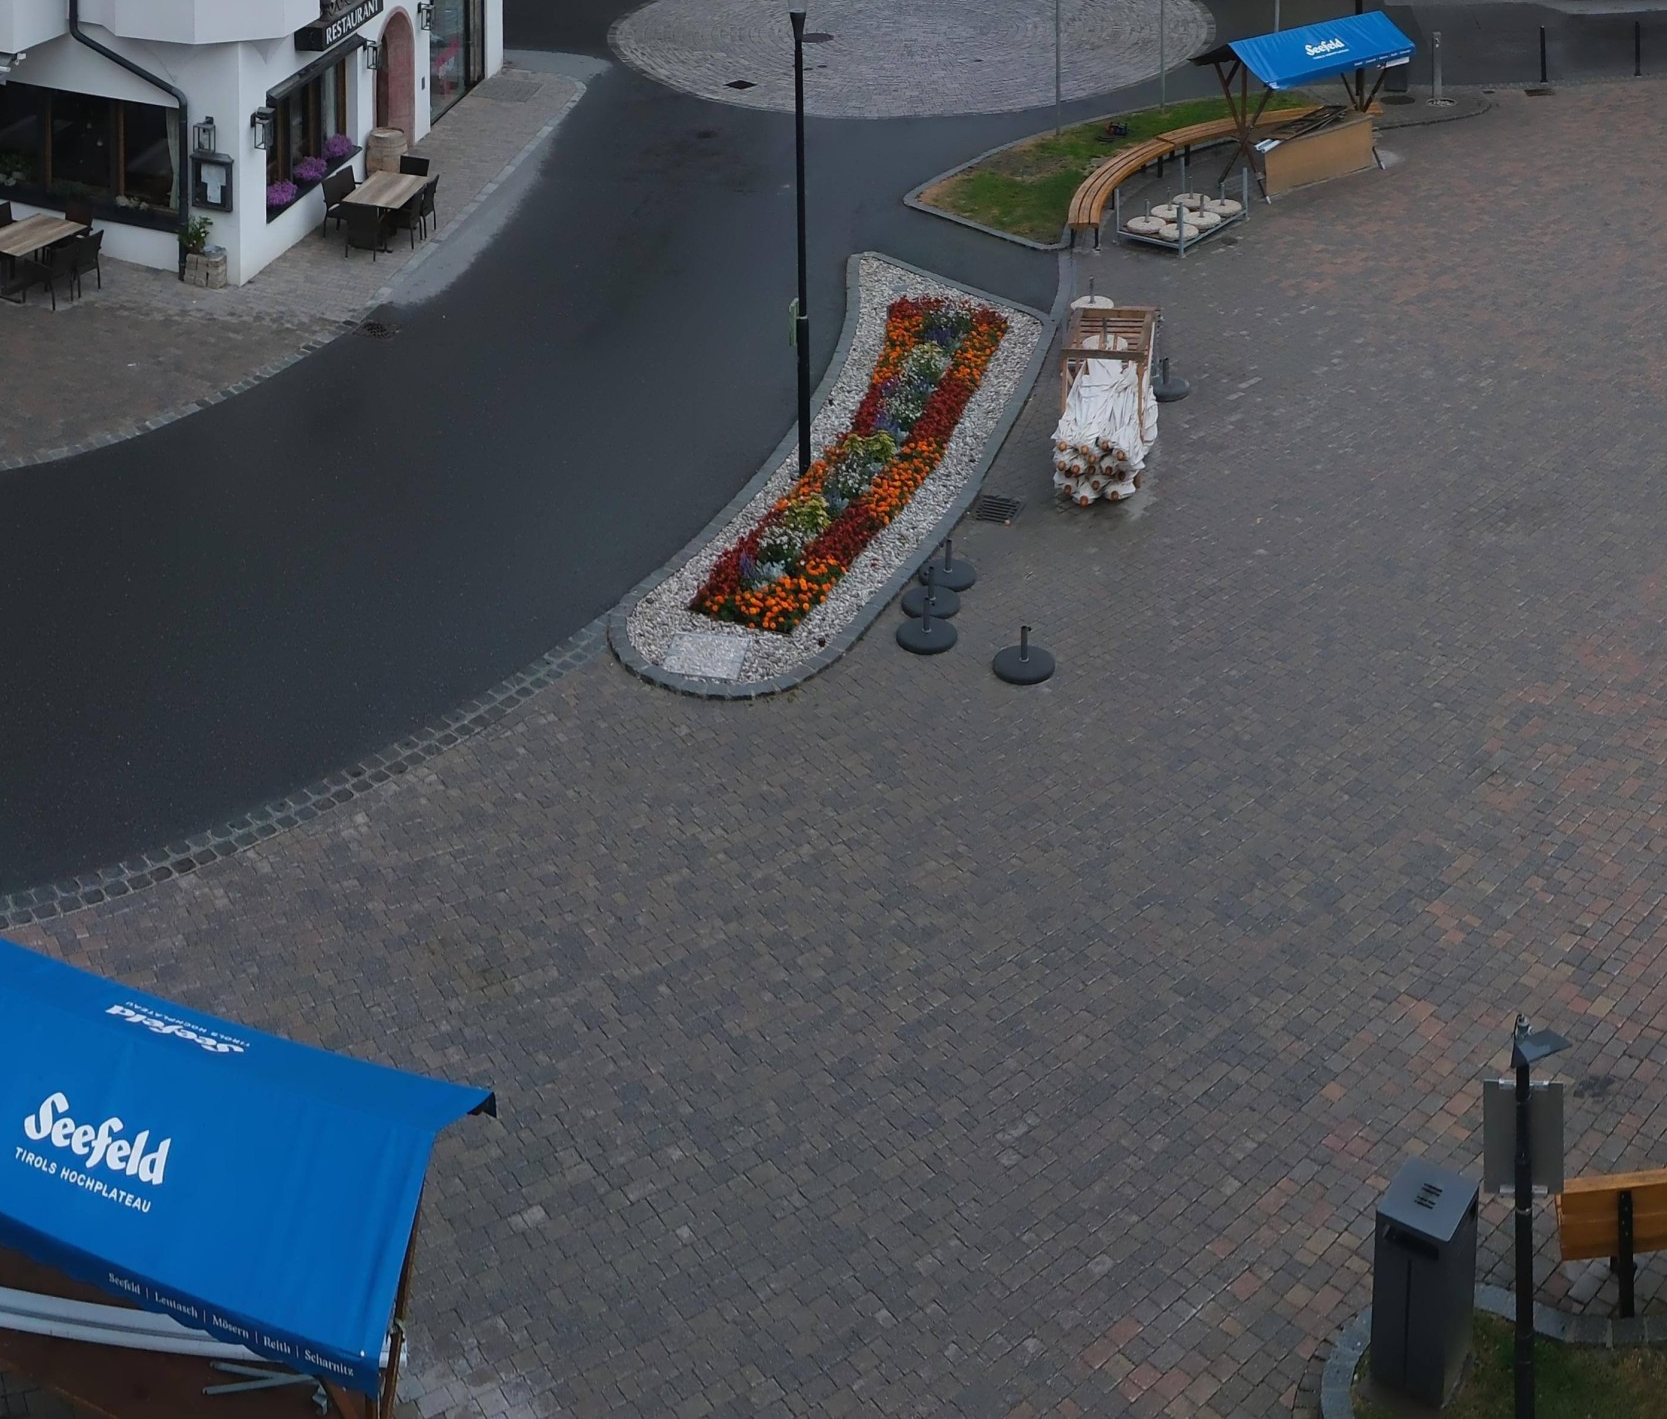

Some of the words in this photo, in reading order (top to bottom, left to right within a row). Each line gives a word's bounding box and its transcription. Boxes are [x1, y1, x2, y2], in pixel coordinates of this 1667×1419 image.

[1305, 38, 1345, 56] Seefeld
[105, 1004, 245, 1053] Seefeld
[24, 1091, 172, 1186] Seefeld
[15, 1147, 57, 1174] TIROLS
[60, 1166, 152, 1214] HOCHPLATEAU
[108, 1273, 141, 1295] Seefeld
[154, 1291, 198, 1319] Leutasch
[212, 1314, 250, 1340] Mösern
[263, 1335, 292, 1355] Reith
[304, 1349, 354, 1377] Scharnitz
